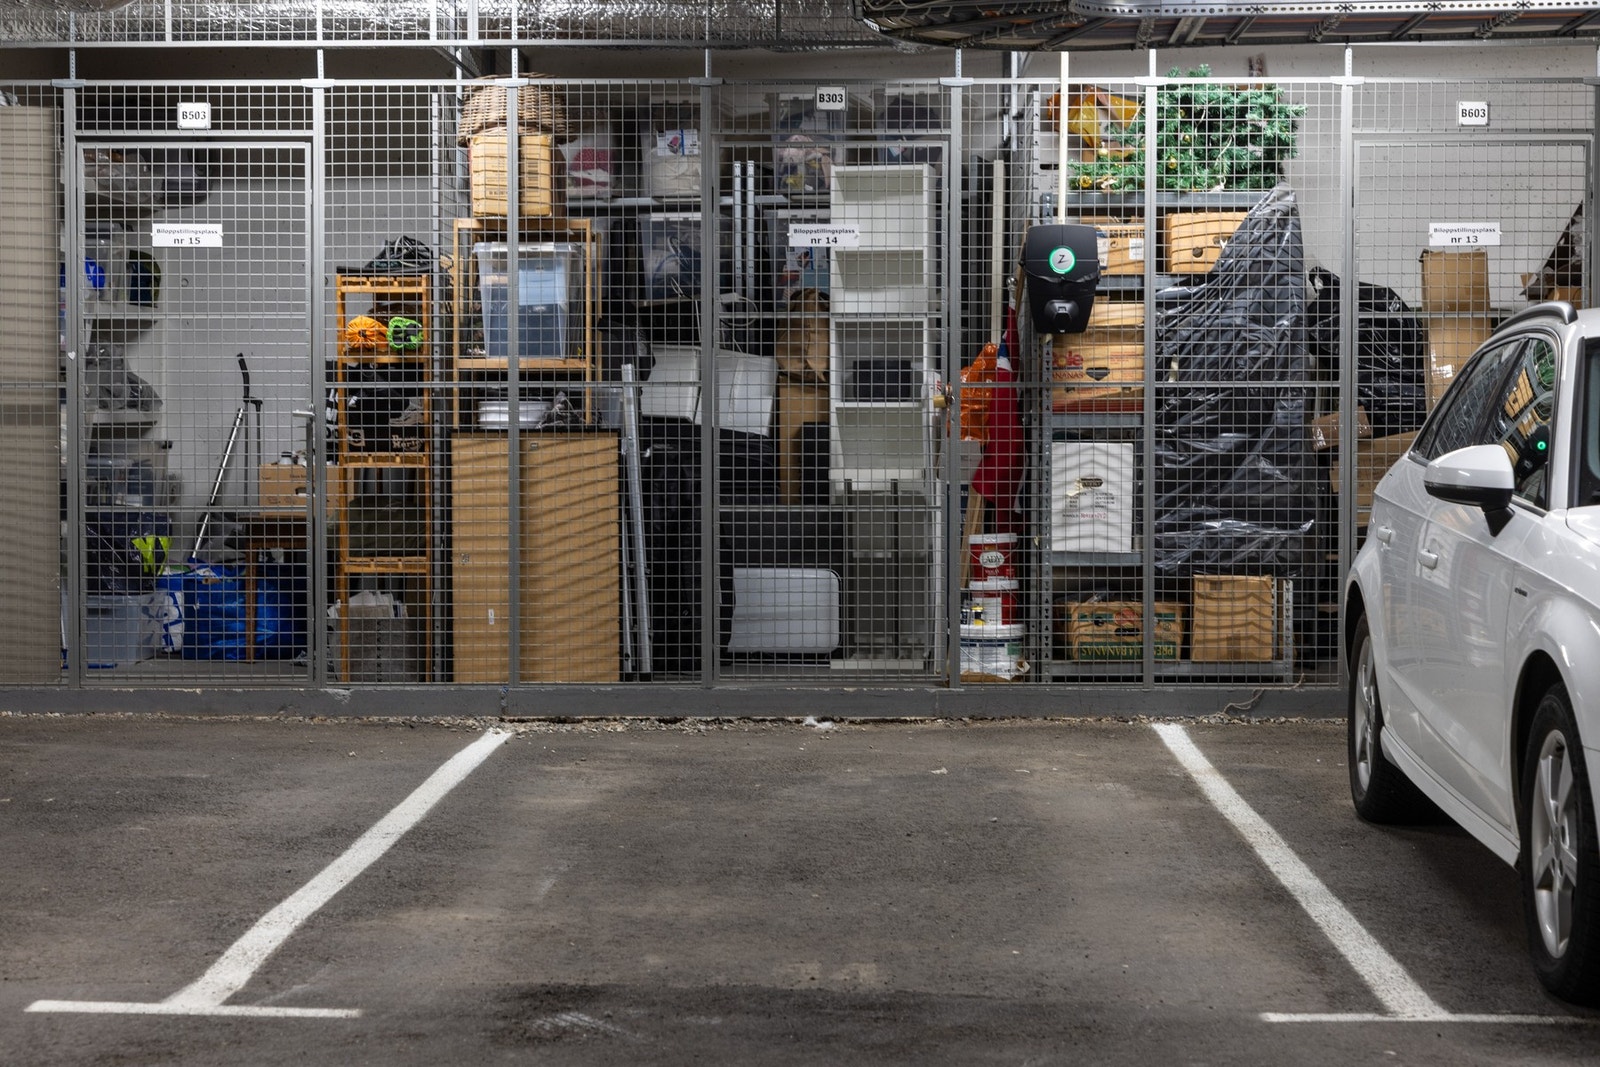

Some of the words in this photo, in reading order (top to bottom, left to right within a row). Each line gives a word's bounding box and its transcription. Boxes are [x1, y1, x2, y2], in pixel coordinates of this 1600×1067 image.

[818, 93, 844, 103] B303
[181, 111, 207, 120] B503
[1461, 108, 1486, 118] B603
[156, 228, 218, 236] Biloppstillingsplass
[793, 228, 855, 236] Biloppstillingsplass
[1433, 227, 1496, 235] Biloppstillingsplass
[174, 237, 185, 245] nr
[189, 237, 201, 245] 15
[810, 237, 821, 245] nr
[826, 236, 838, 245] 14
[1451, 236, 1462, 244] nr
[1465, 235, 1479, 244] 13
